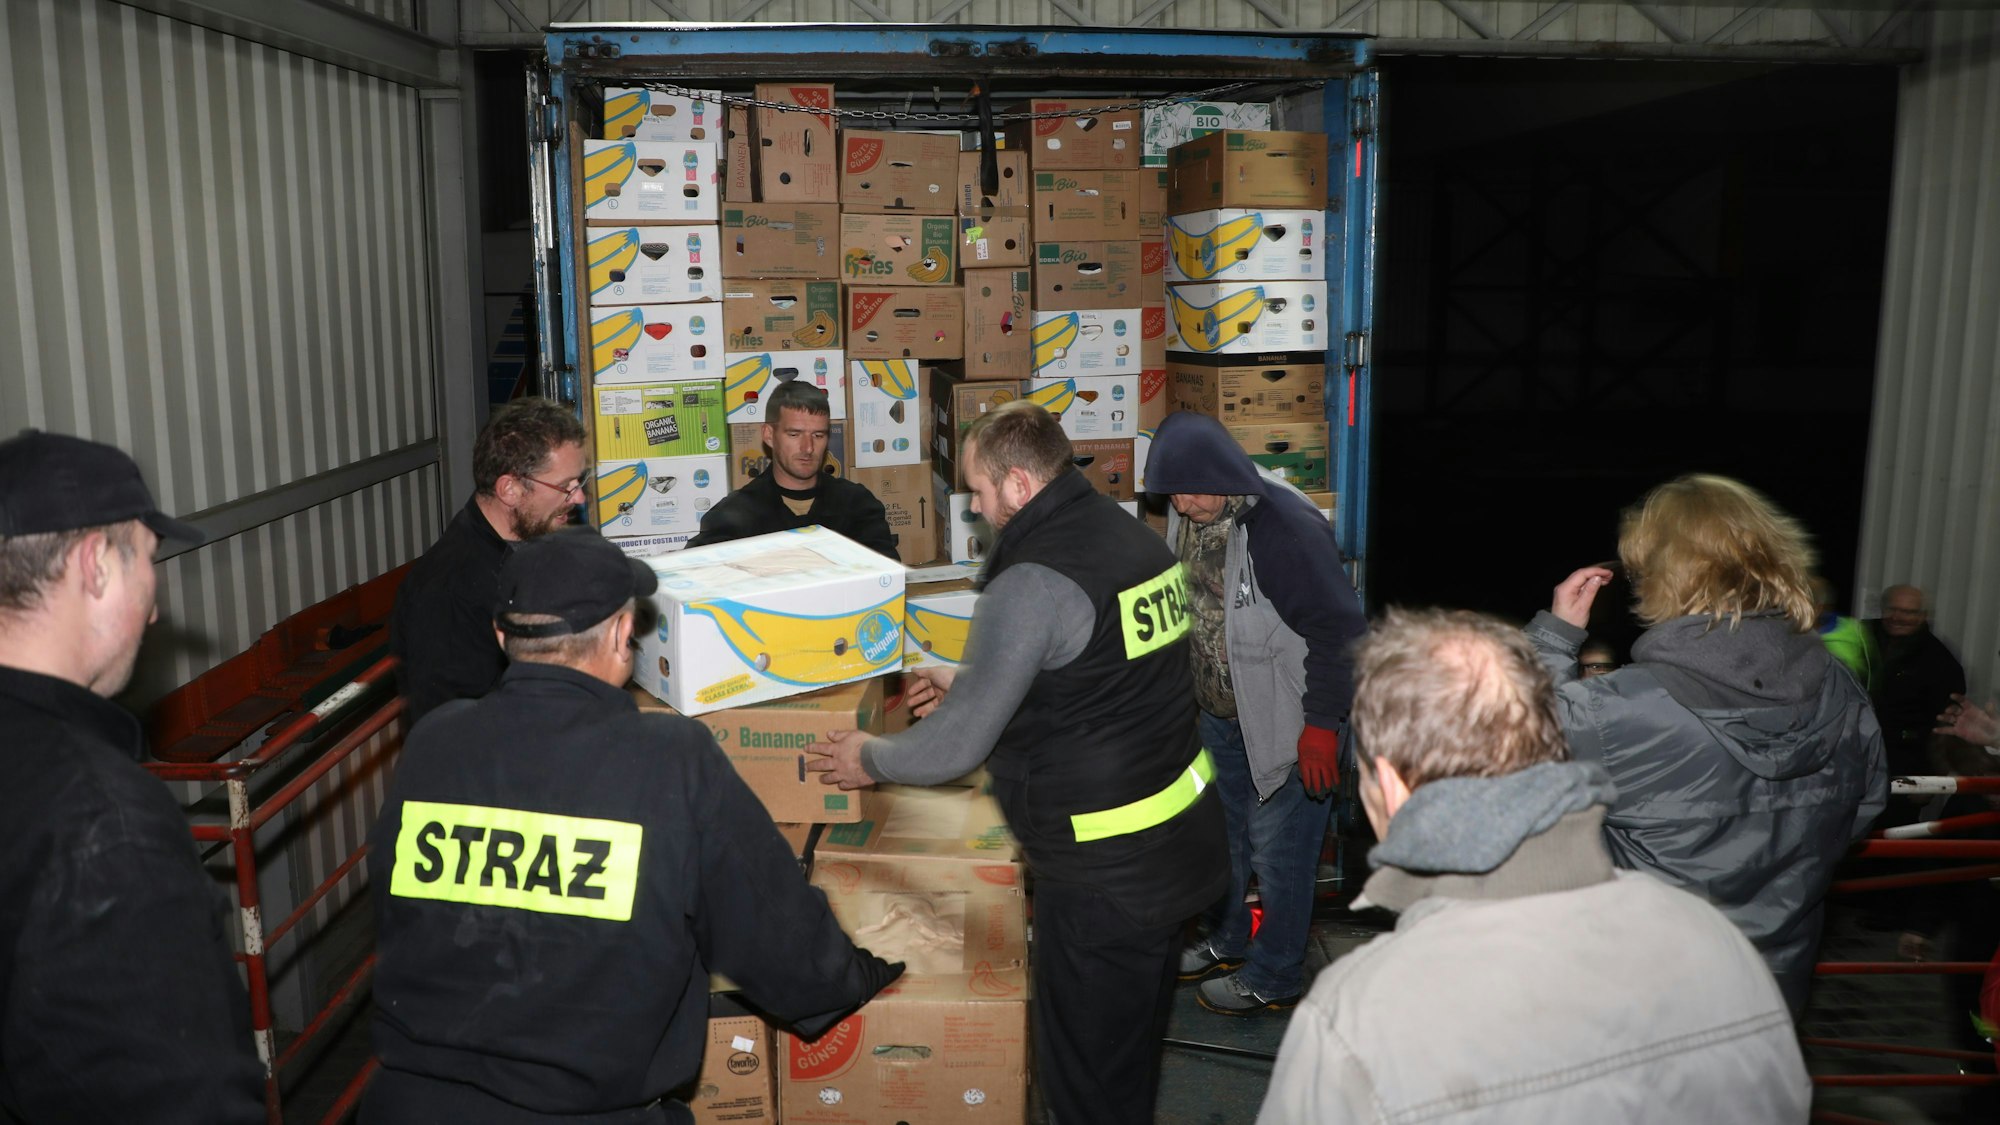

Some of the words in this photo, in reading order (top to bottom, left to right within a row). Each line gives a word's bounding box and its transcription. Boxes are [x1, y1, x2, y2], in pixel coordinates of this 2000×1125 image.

[1196, 116, 1220, 127] BIO
[736, 142, 747, 188] BANANEN
[1055, 178, 1078, 191] Bio
[744, 215, 768, 227] Bio
[926, 222, 949, 231] Organic
[1061, 249, 1088, 264] Bio
[1011, 293, 1025, 319] Bio
[1175, 371, 1204, 386] BANANAS
[644, 416, 675, 430] ORGANIC
[646, 424, 678, 439] BANANAS
[643, 538, 651, 546] OF
[652, 537, 673, 545] COSTA
[673, 535, 689, 543] RICA
[864, 627, 900, 662] Chiquita
[704, 689, 727, 703] CLASS
[727, 682, 750, 695] EXTRA
[739, 726, 816, 749] Bananen
[797, 1021, 850, 1070] GÜNSTIG
[730, 1056, 757, 1069] favorita
